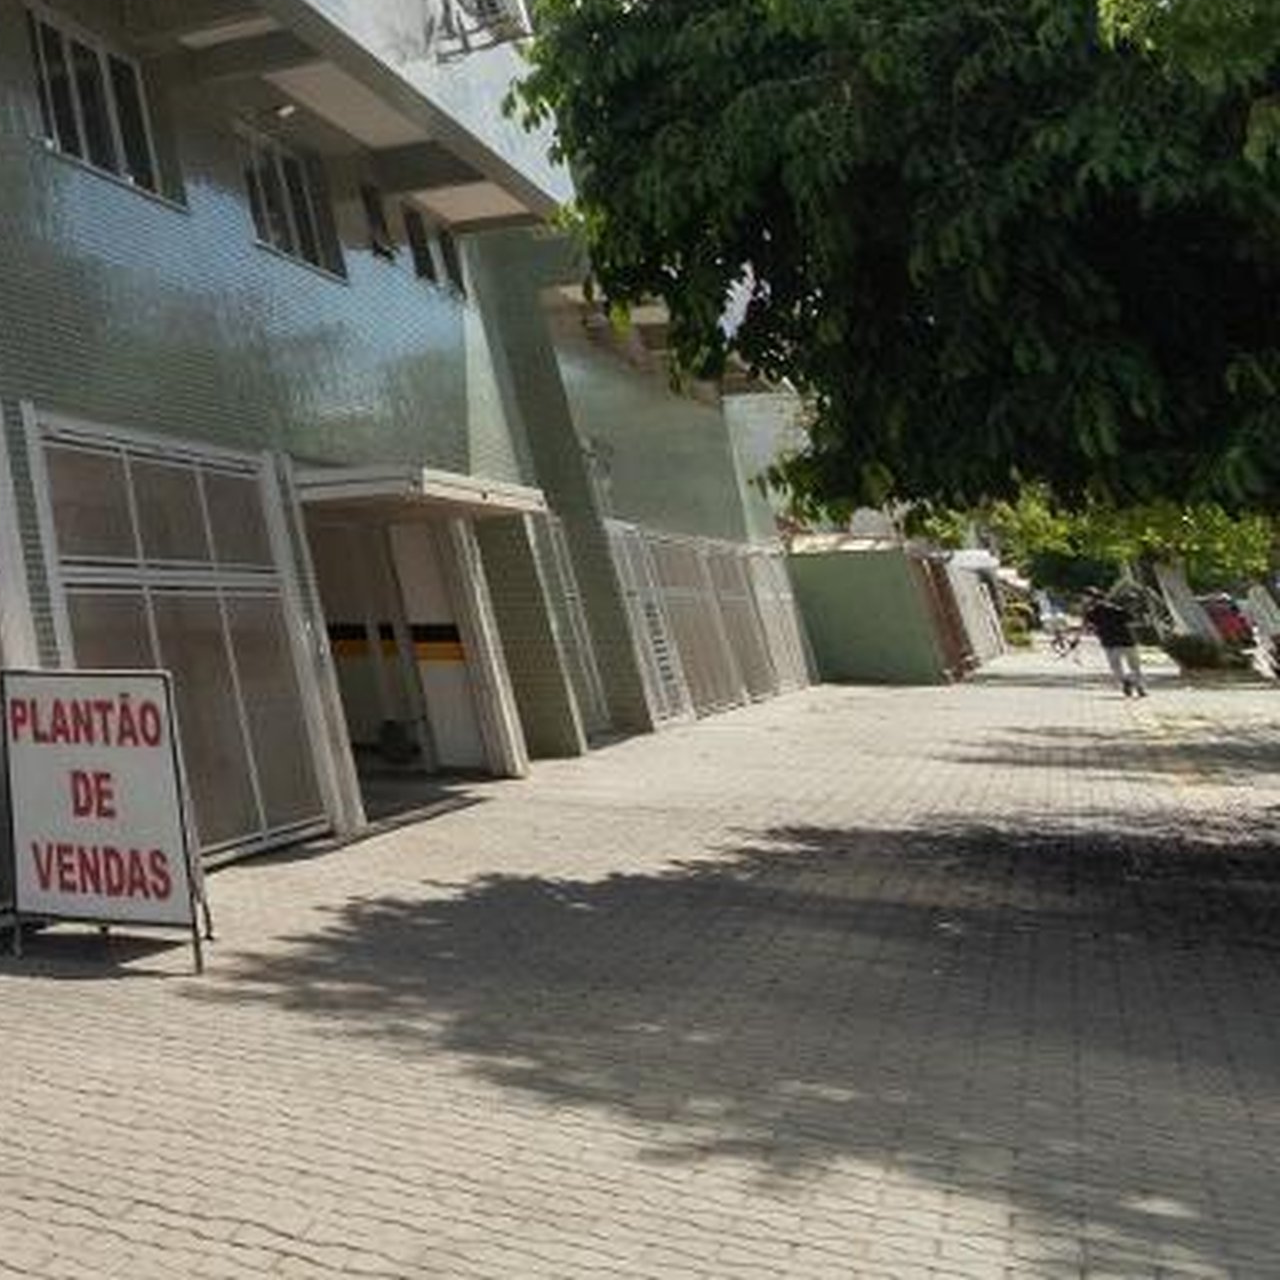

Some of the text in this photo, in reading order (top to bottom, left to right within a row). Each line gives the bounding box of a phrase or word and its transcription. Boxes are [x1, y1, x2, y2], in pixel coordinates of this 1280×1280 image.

[9, 692, 162, 748] PLANTÃO
[70, 770, 116, 819] DE
[31, 841, 172, 900] VENDAS
